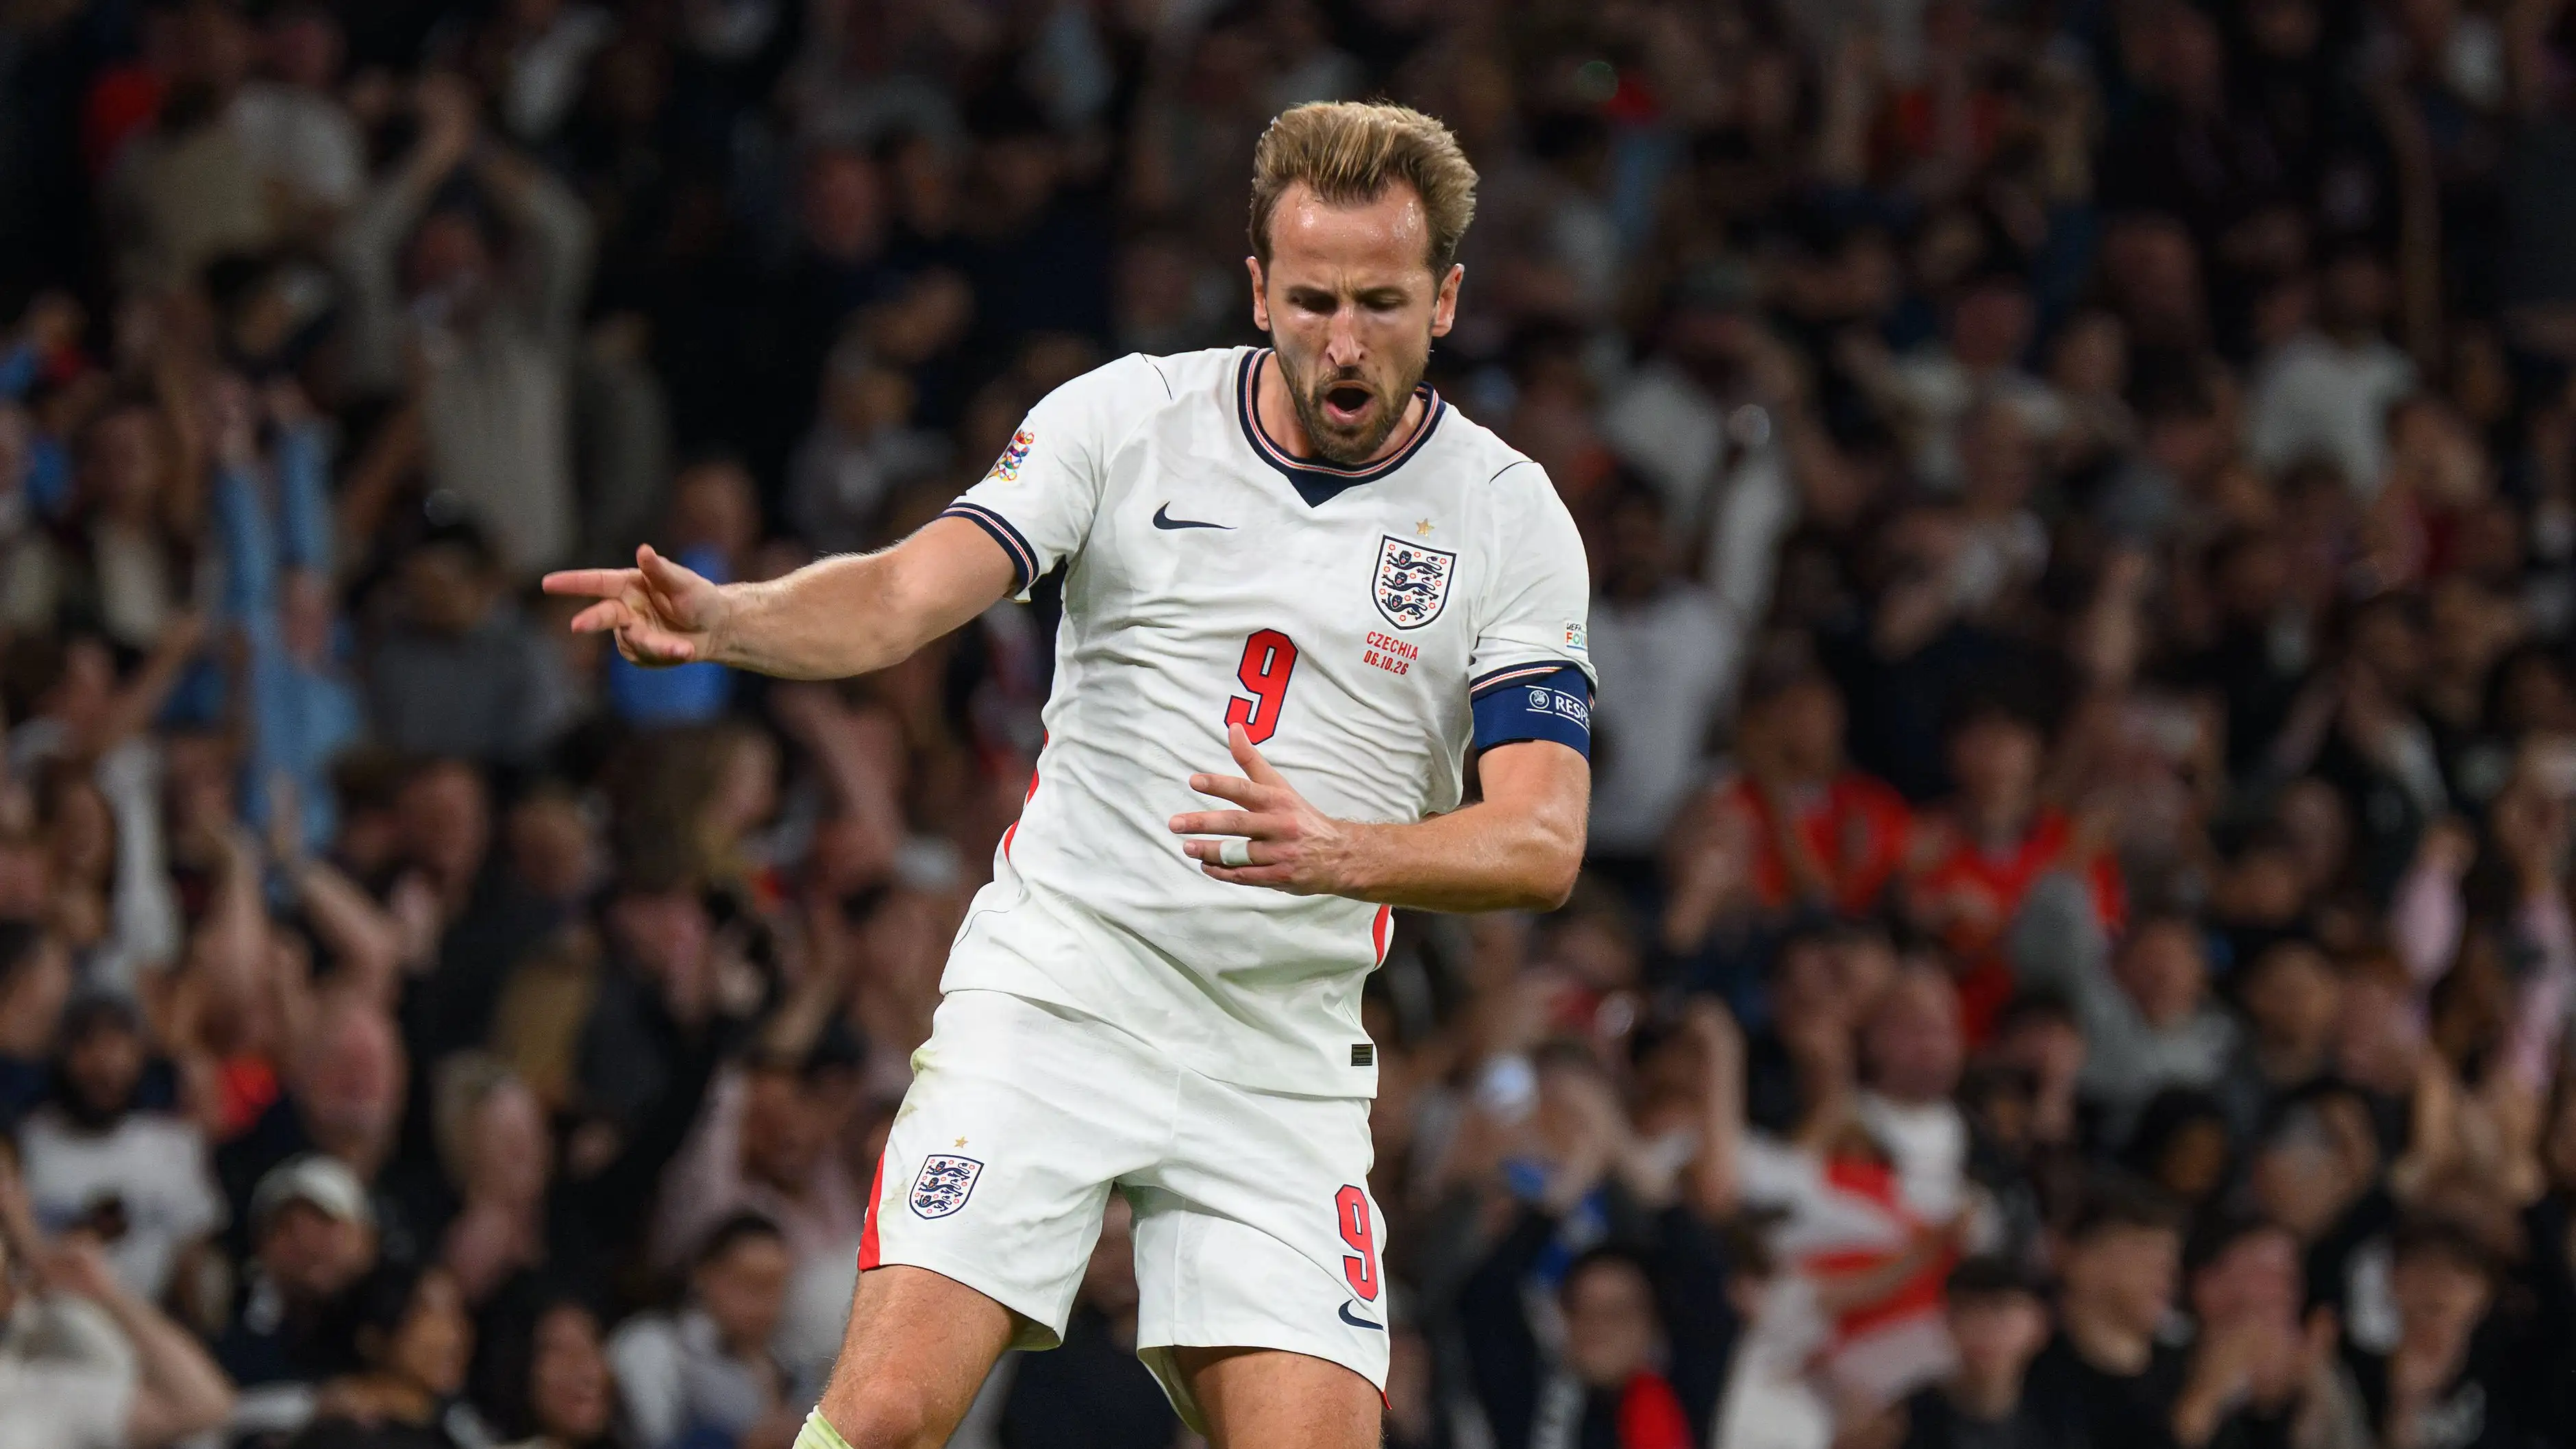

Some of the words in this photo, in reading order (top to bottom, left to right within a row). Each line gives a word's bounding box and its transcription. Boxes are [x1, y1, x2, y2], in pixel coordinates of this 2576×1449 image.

[1363, 649, 1409, 675] 06.10.26
[1367, 631, 1418, 660] CZECHIA
[1224, 628, 1298, 745] 9
[1335, 1184, 1378, 1302] 9
